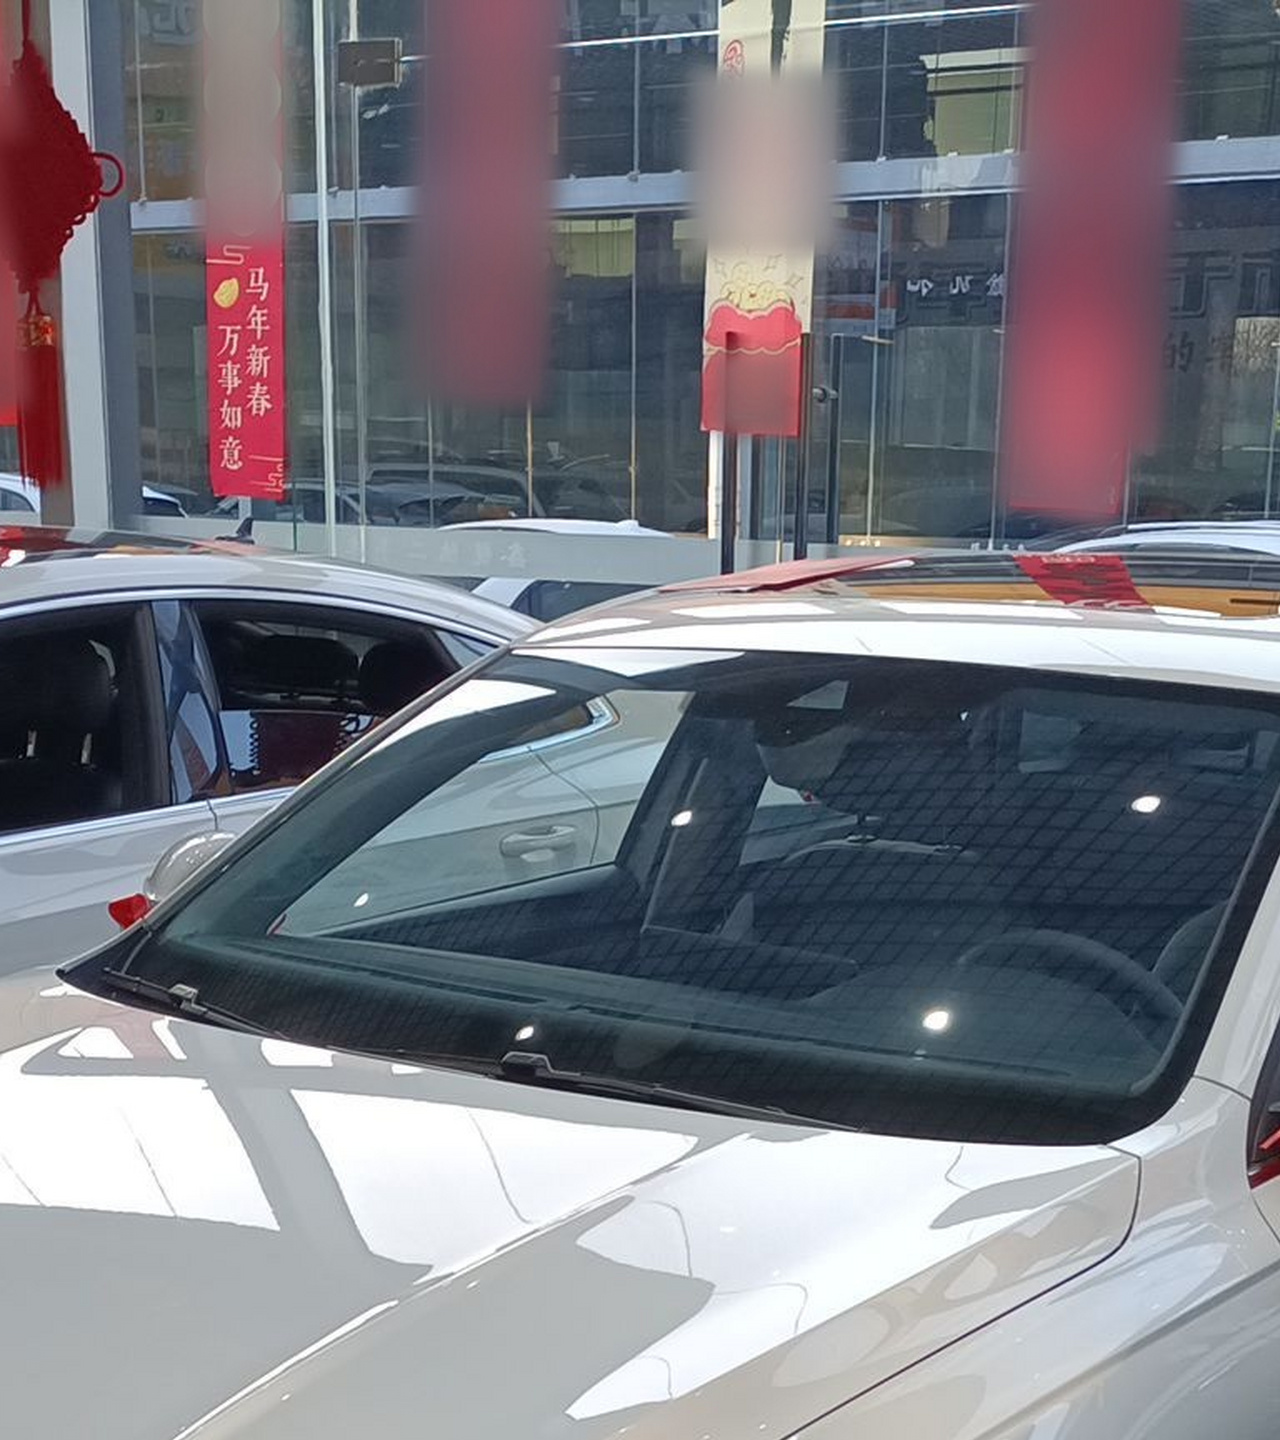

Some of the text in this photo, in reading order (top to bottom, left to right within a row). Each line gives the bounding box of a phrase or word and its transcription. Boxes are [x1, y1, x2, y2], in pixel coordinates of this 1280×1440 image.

[217, 325, 243, 470] 万事如意
[246, 267, 272, 417] 马年新春
